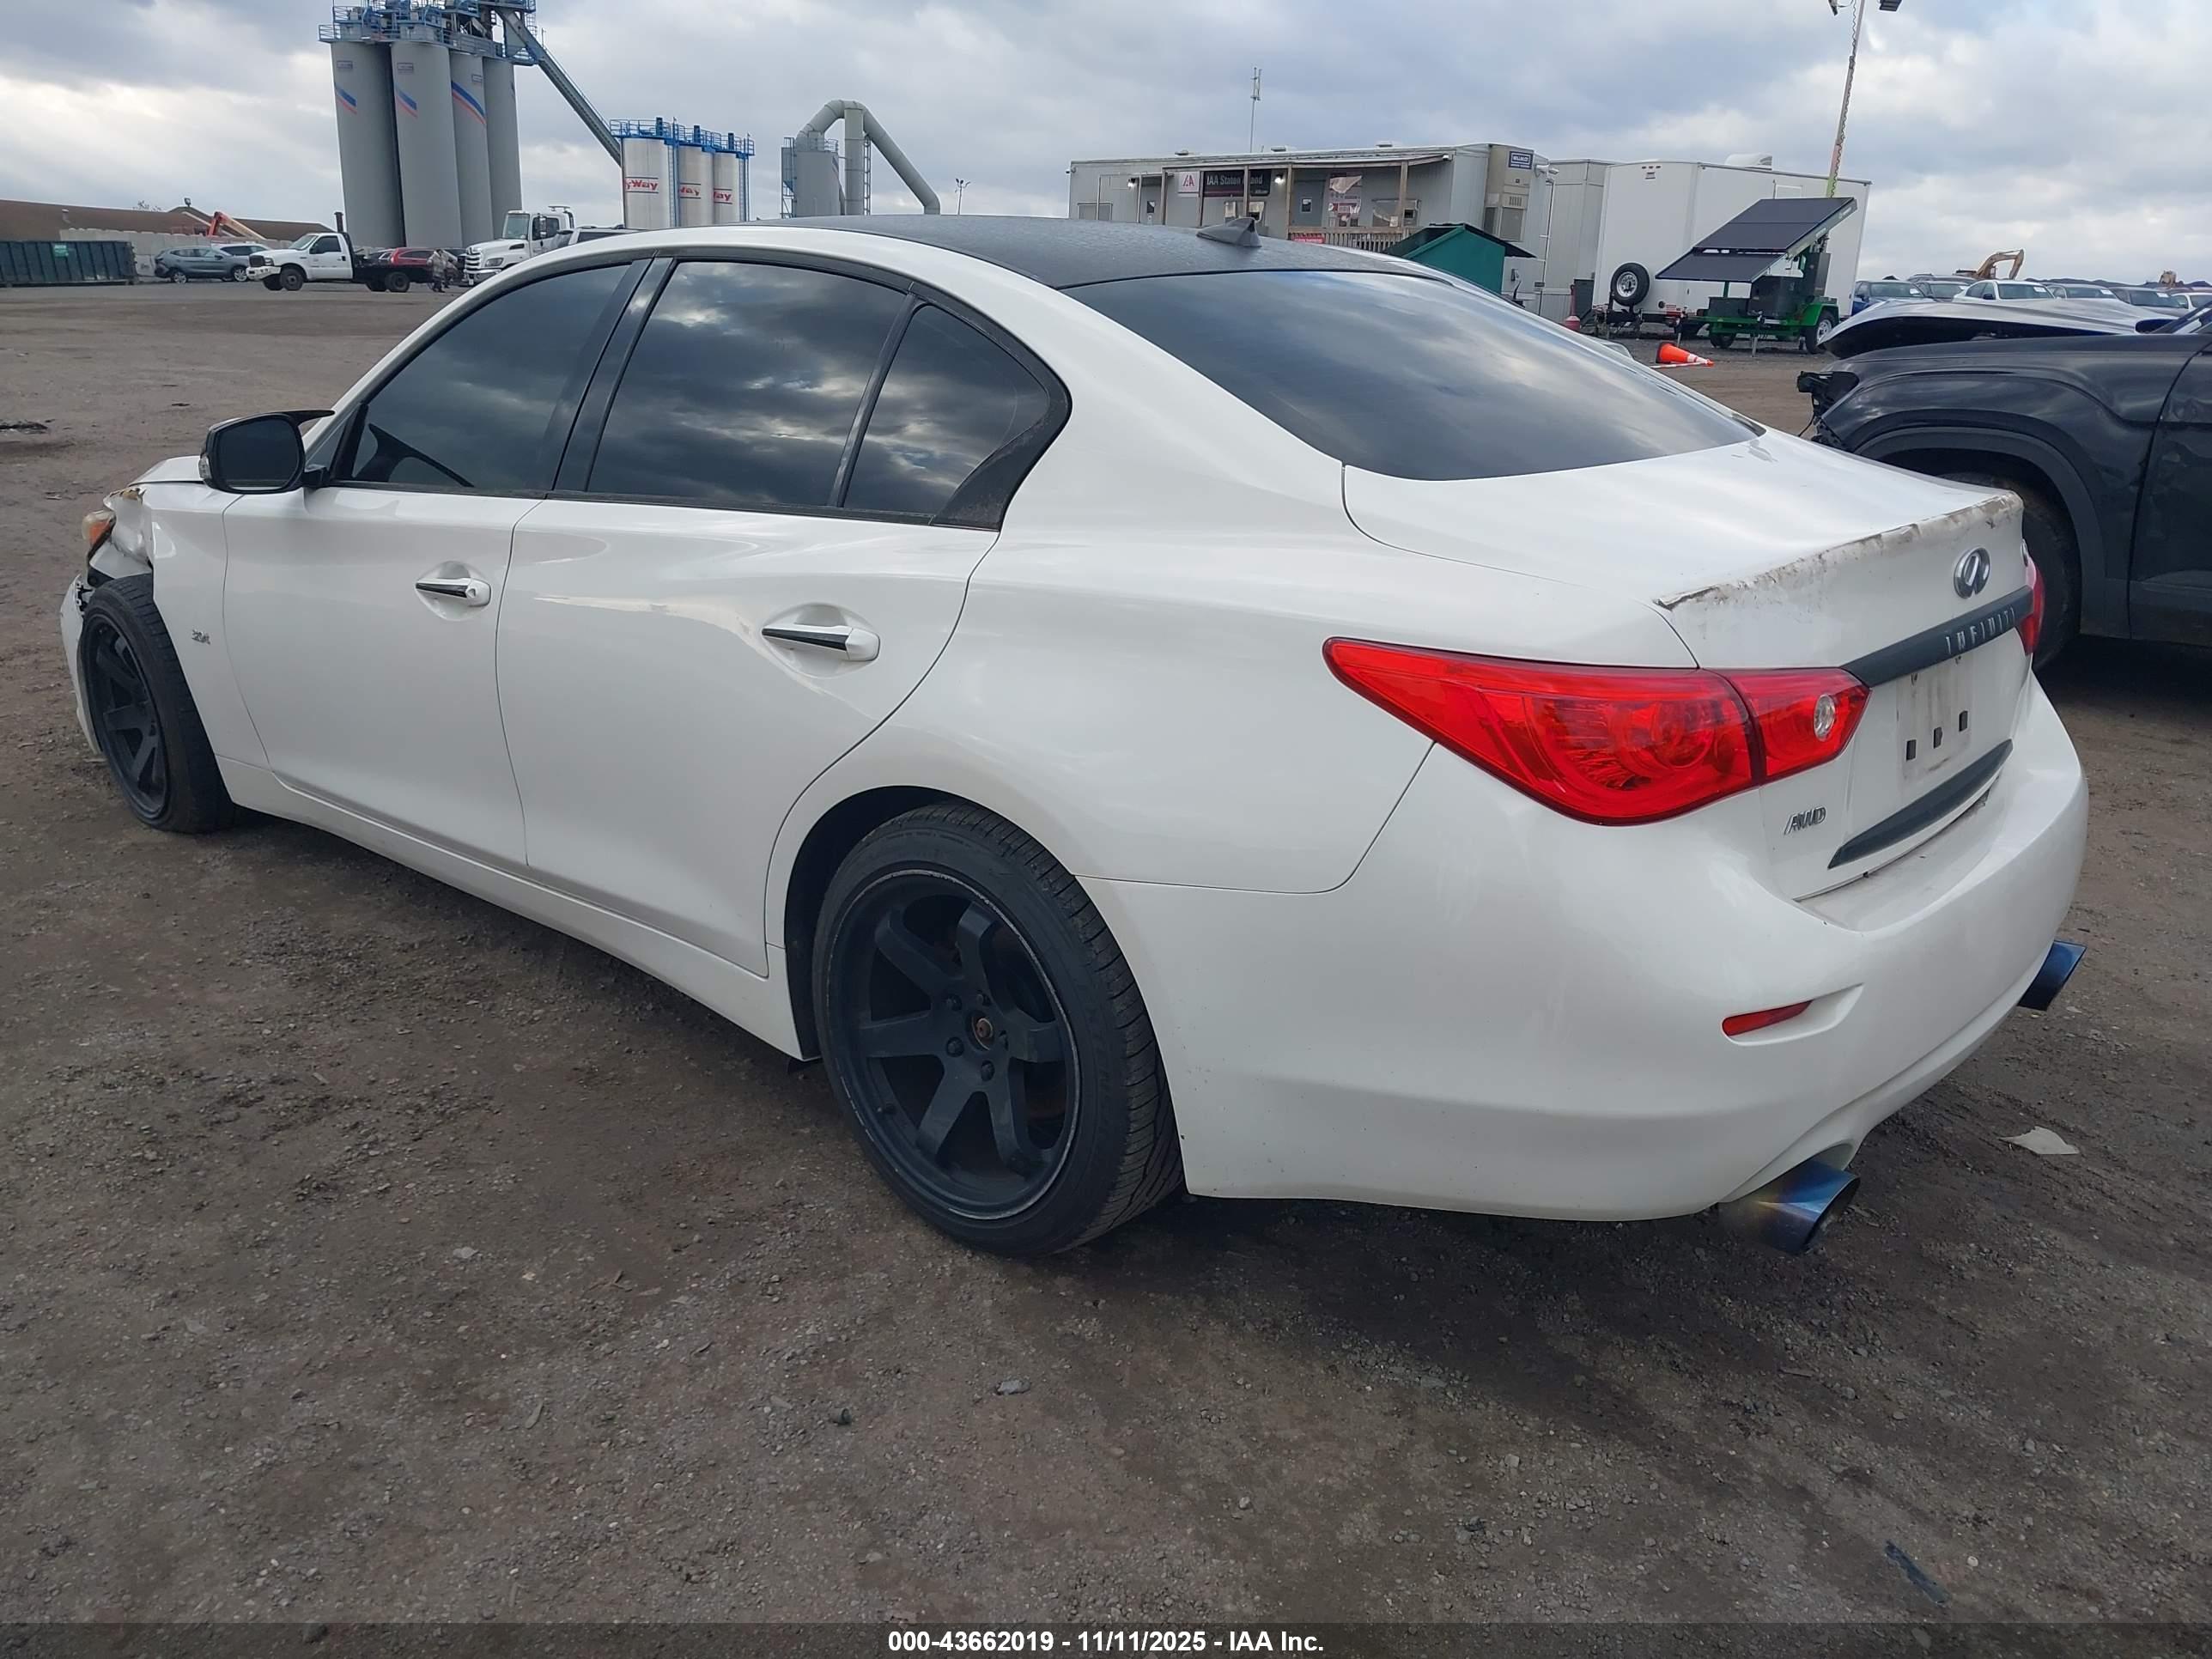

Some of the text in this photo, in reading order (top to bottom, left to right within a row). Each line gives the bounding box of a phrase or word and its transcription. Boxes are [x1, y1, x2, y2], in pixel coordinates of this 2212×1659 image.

[1206, 174, 1219, 185] IAA
[1945, 606, 2015, 654] INFINITI
[1784, 806, 1826, 836] AWD
